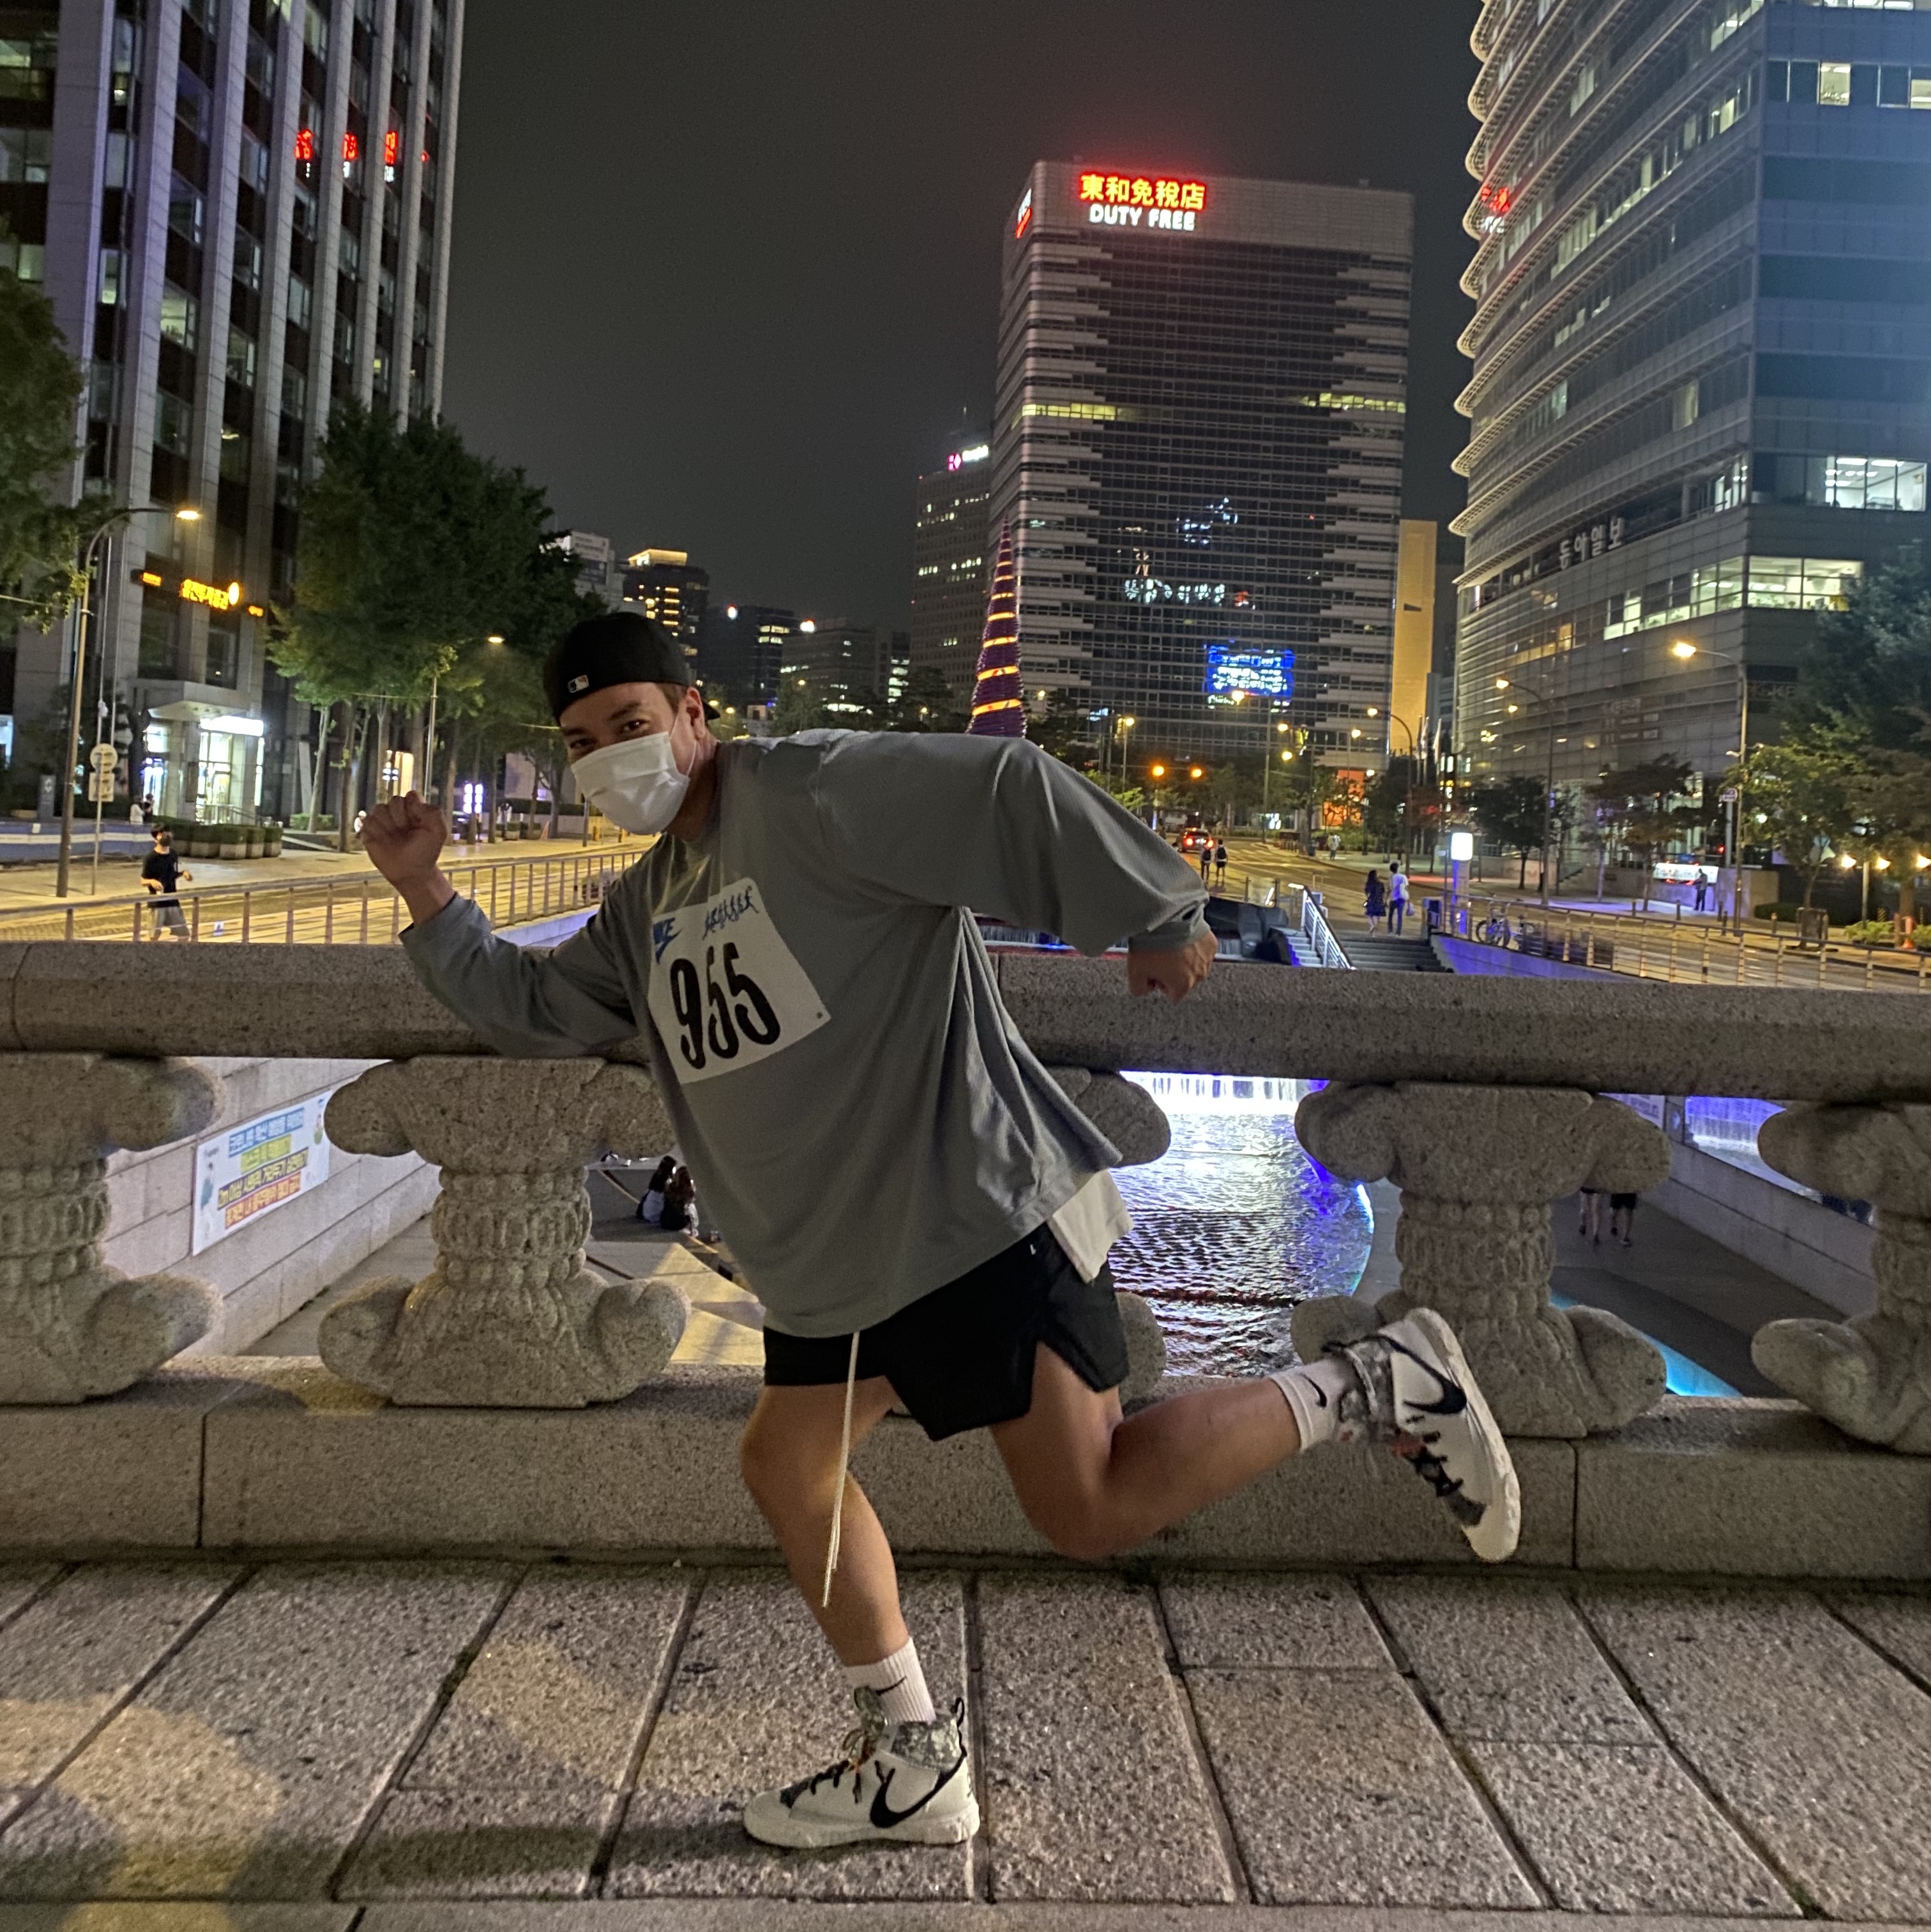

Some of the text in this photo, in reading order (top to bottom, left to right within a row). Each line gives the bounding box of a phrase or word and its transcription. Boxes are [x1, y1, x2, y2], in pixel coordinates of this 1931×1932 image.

[1089, 203, 1196, 231] DUTY FREE
[1559, 516, 1625, 570] 동아일보
[670, 942, 780, 1069] 955
